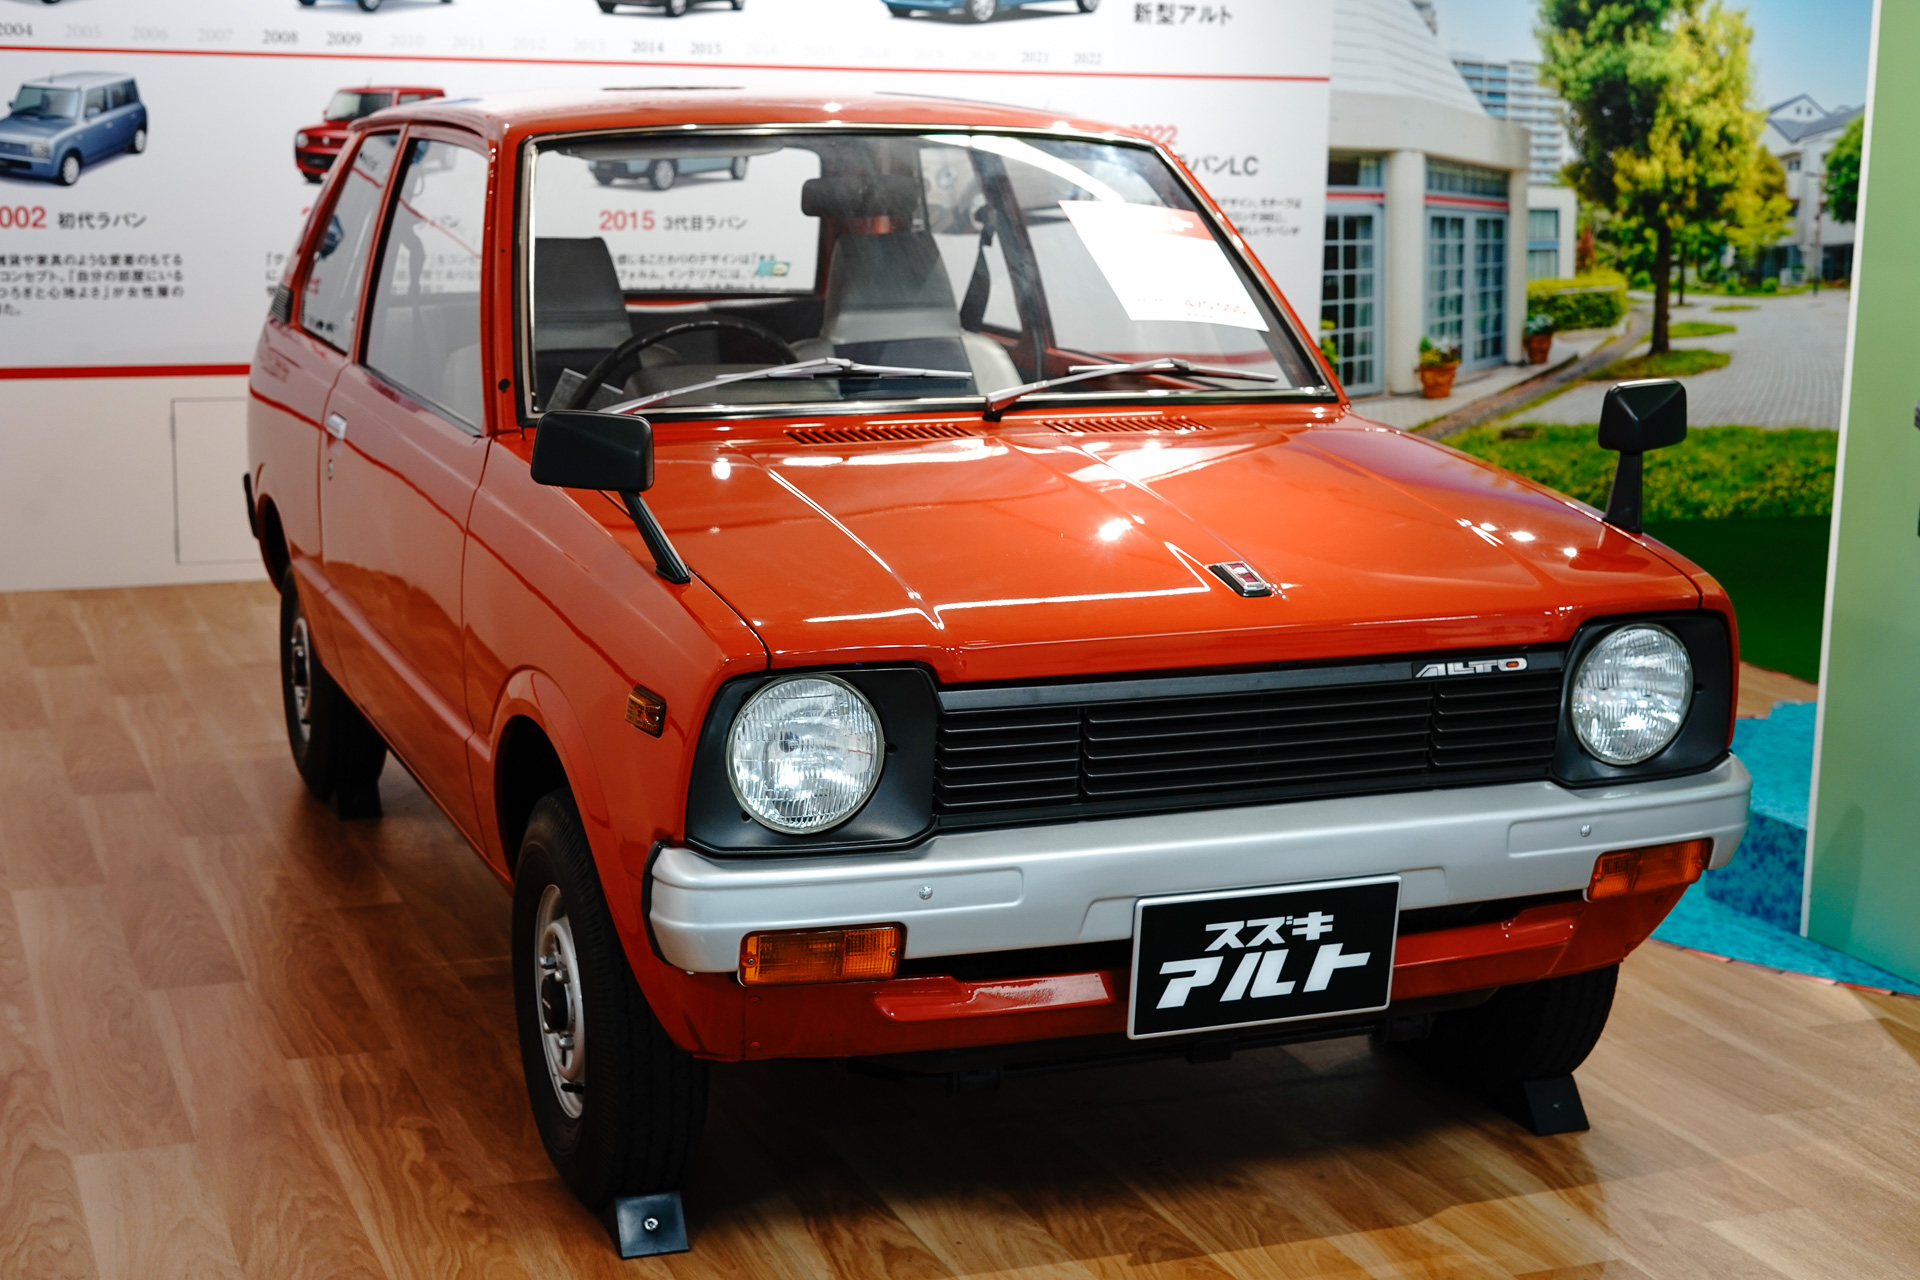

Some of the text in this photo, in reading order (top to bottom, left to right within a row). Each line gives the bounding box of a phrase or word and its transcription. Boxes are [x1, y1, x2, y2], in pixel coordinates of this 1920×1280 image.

[1134, 3, 1232, 25] 新型アルト
[262, 29, 299, 44] 2008
[326, 31, 362, 46] 2009
[632, 40, 664, 54] 2014
[690, 41, 722, 56] 2015
[1021, 50, 1049, 64] 2021
[1073, 51, 1103, 65] 2022
[57, 212, 146, 230] 初代ラパン
[599, 210, 746, 231] 2015 3代目ラパン
[1415, 657, 1528, 678] ALTO
[1204, 911, 1334, 951] スズキ
[1155, 942, 1371, 1009] アルト
